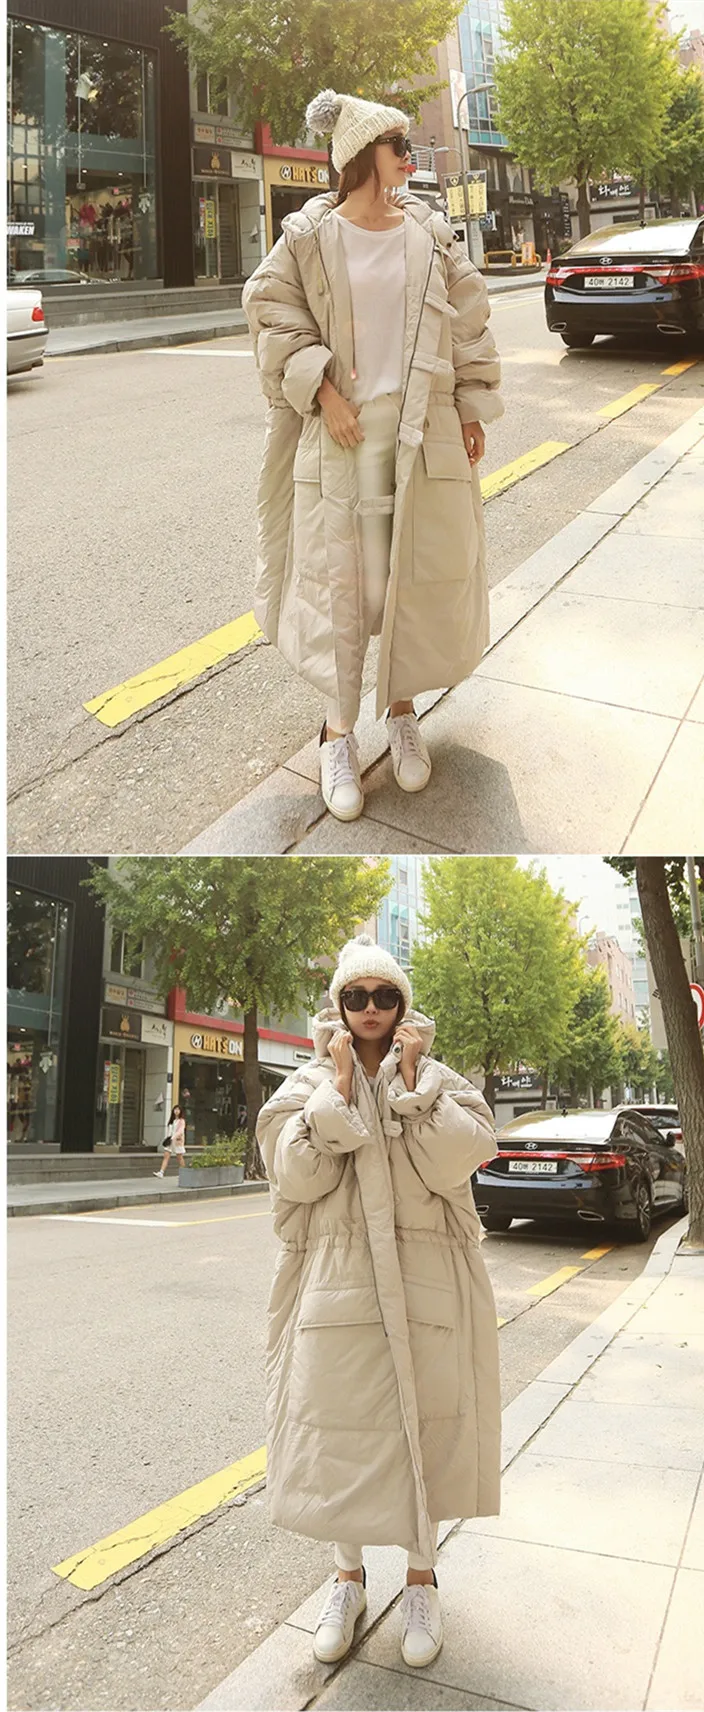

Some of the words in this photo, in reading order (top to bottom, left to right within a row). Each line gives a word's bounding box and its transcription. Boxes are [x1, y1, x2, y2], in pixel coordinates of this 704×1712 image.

[608, 278, 630, 286] 2142
[228, 1039, 243, 1056] ON
[532, 1163, 553, 1171] 2142
